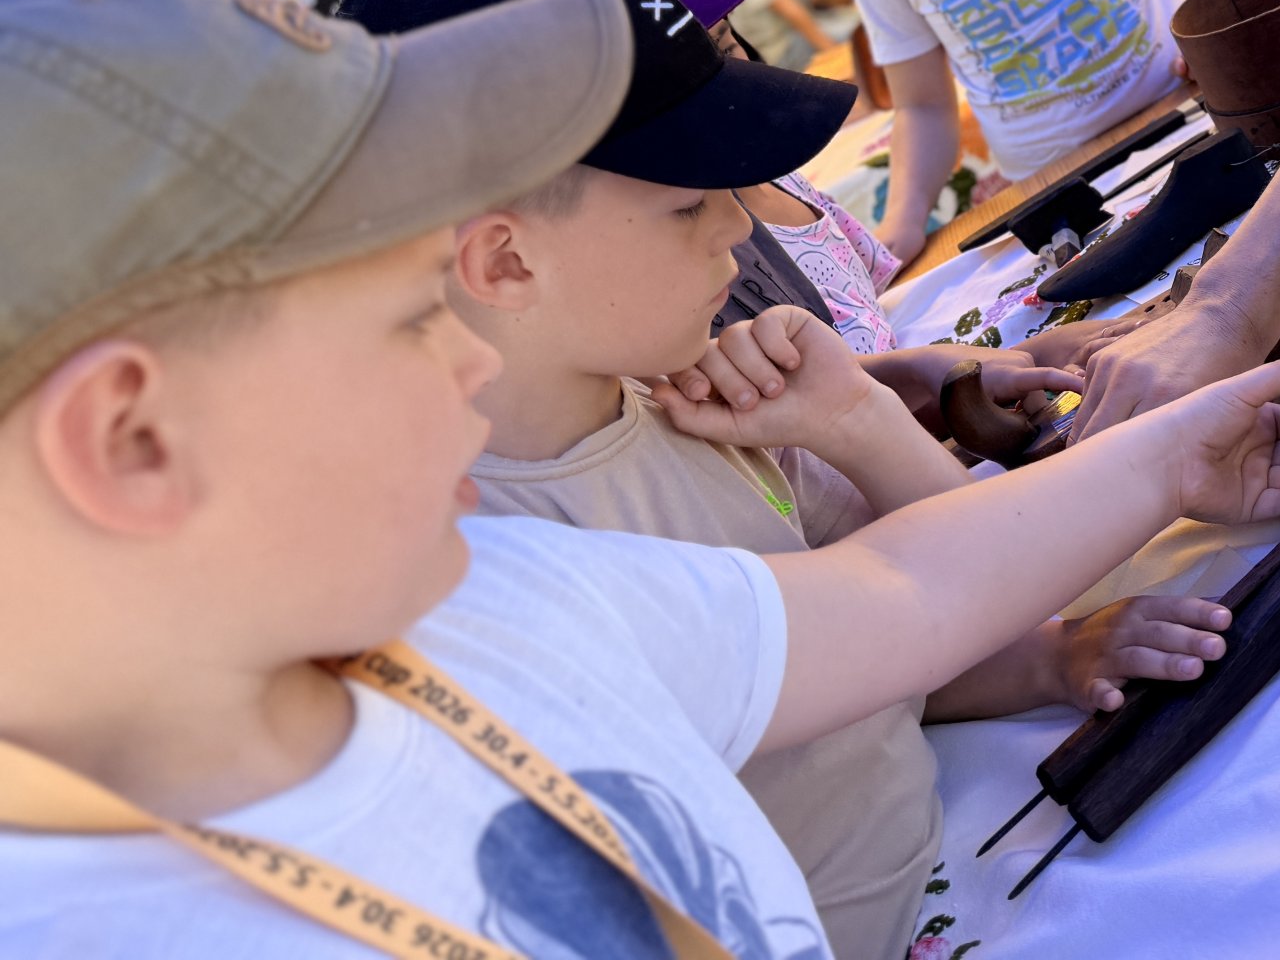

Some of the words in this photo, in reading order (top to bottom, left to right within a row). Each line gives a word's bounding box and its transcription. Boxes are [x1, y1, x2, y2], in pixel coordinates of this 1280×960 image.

[994, 0, 1142, 98] SKATE
[409, 674, 474, 726] 2026
[473, 723, 529, 770] 30.4
[333, 884, 406, 936] 30.4
